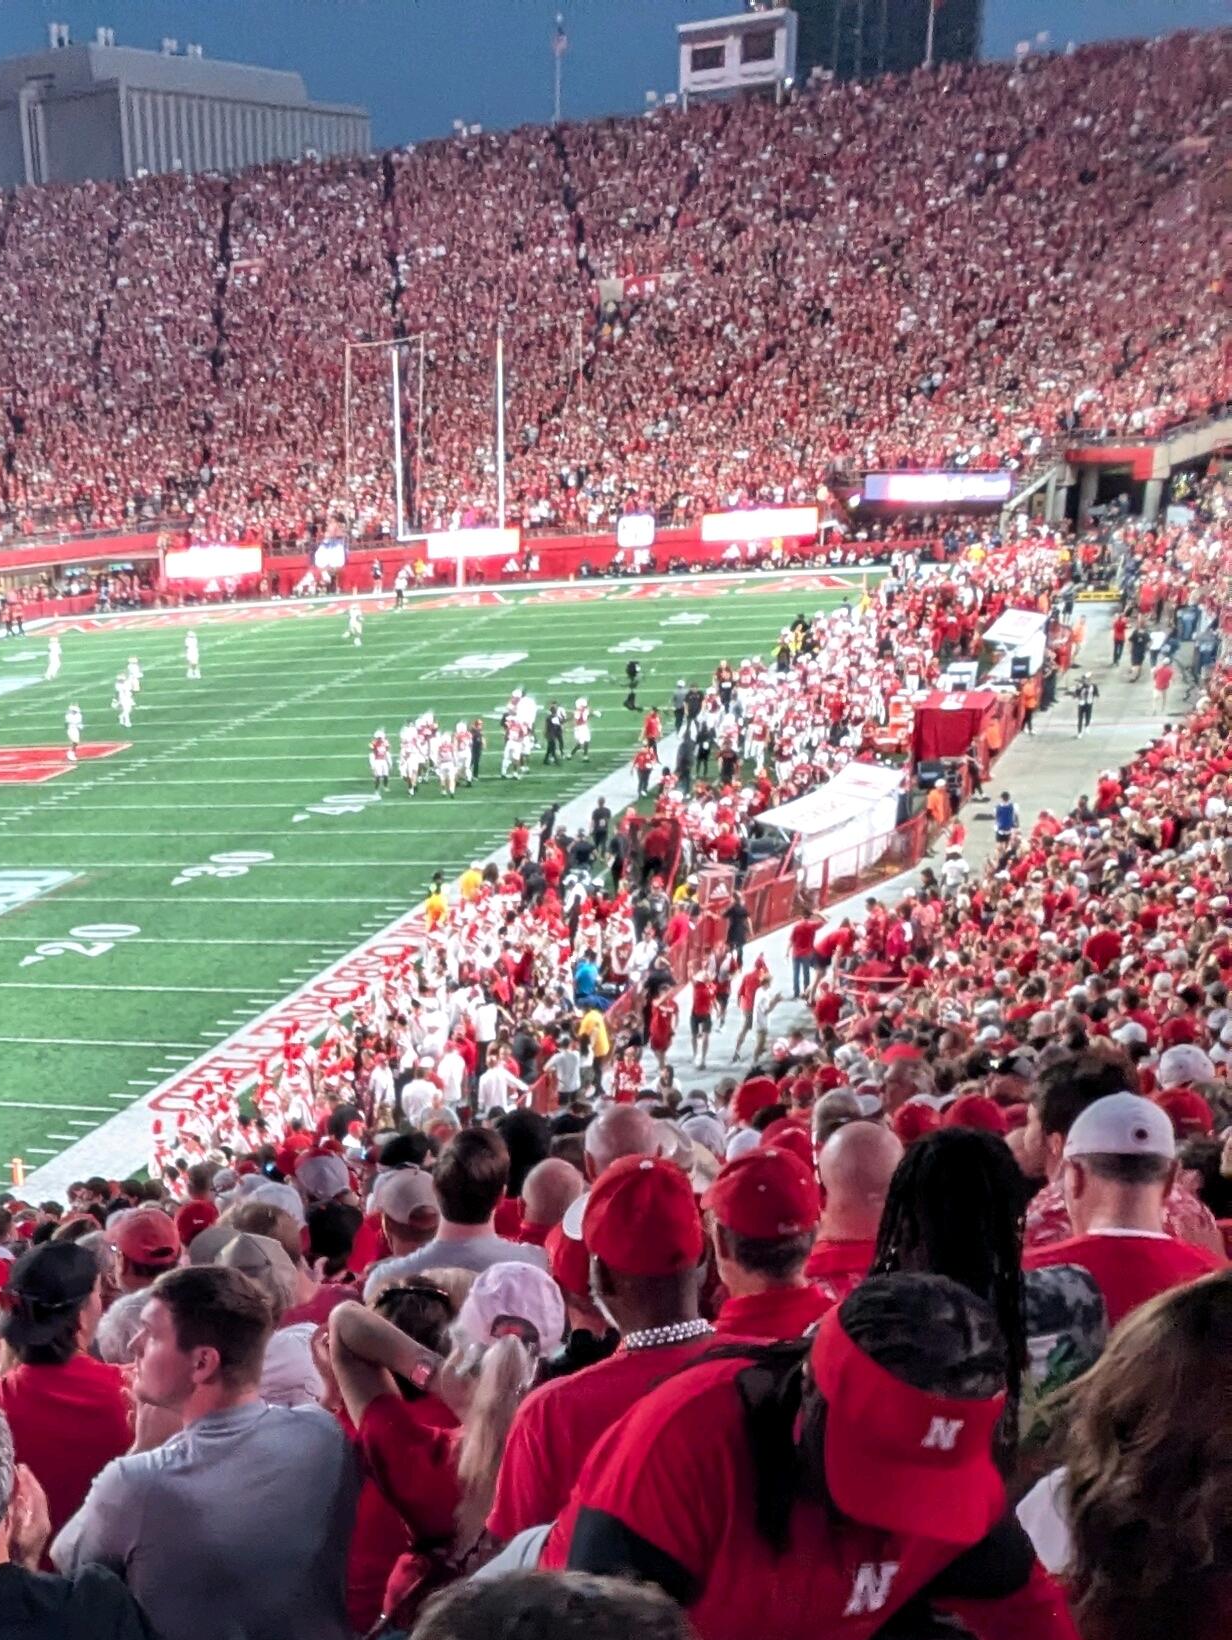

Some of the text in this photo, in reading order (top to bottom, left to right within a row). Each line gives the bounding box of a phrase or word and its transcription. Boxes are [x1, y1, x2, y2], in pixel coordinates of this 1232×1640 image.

[182, 850, 275, 878] 30
[33, 922, 142, 957] 20
[921, 1415, 965, 1450] N
[841, 1560, 902, 1617] N
